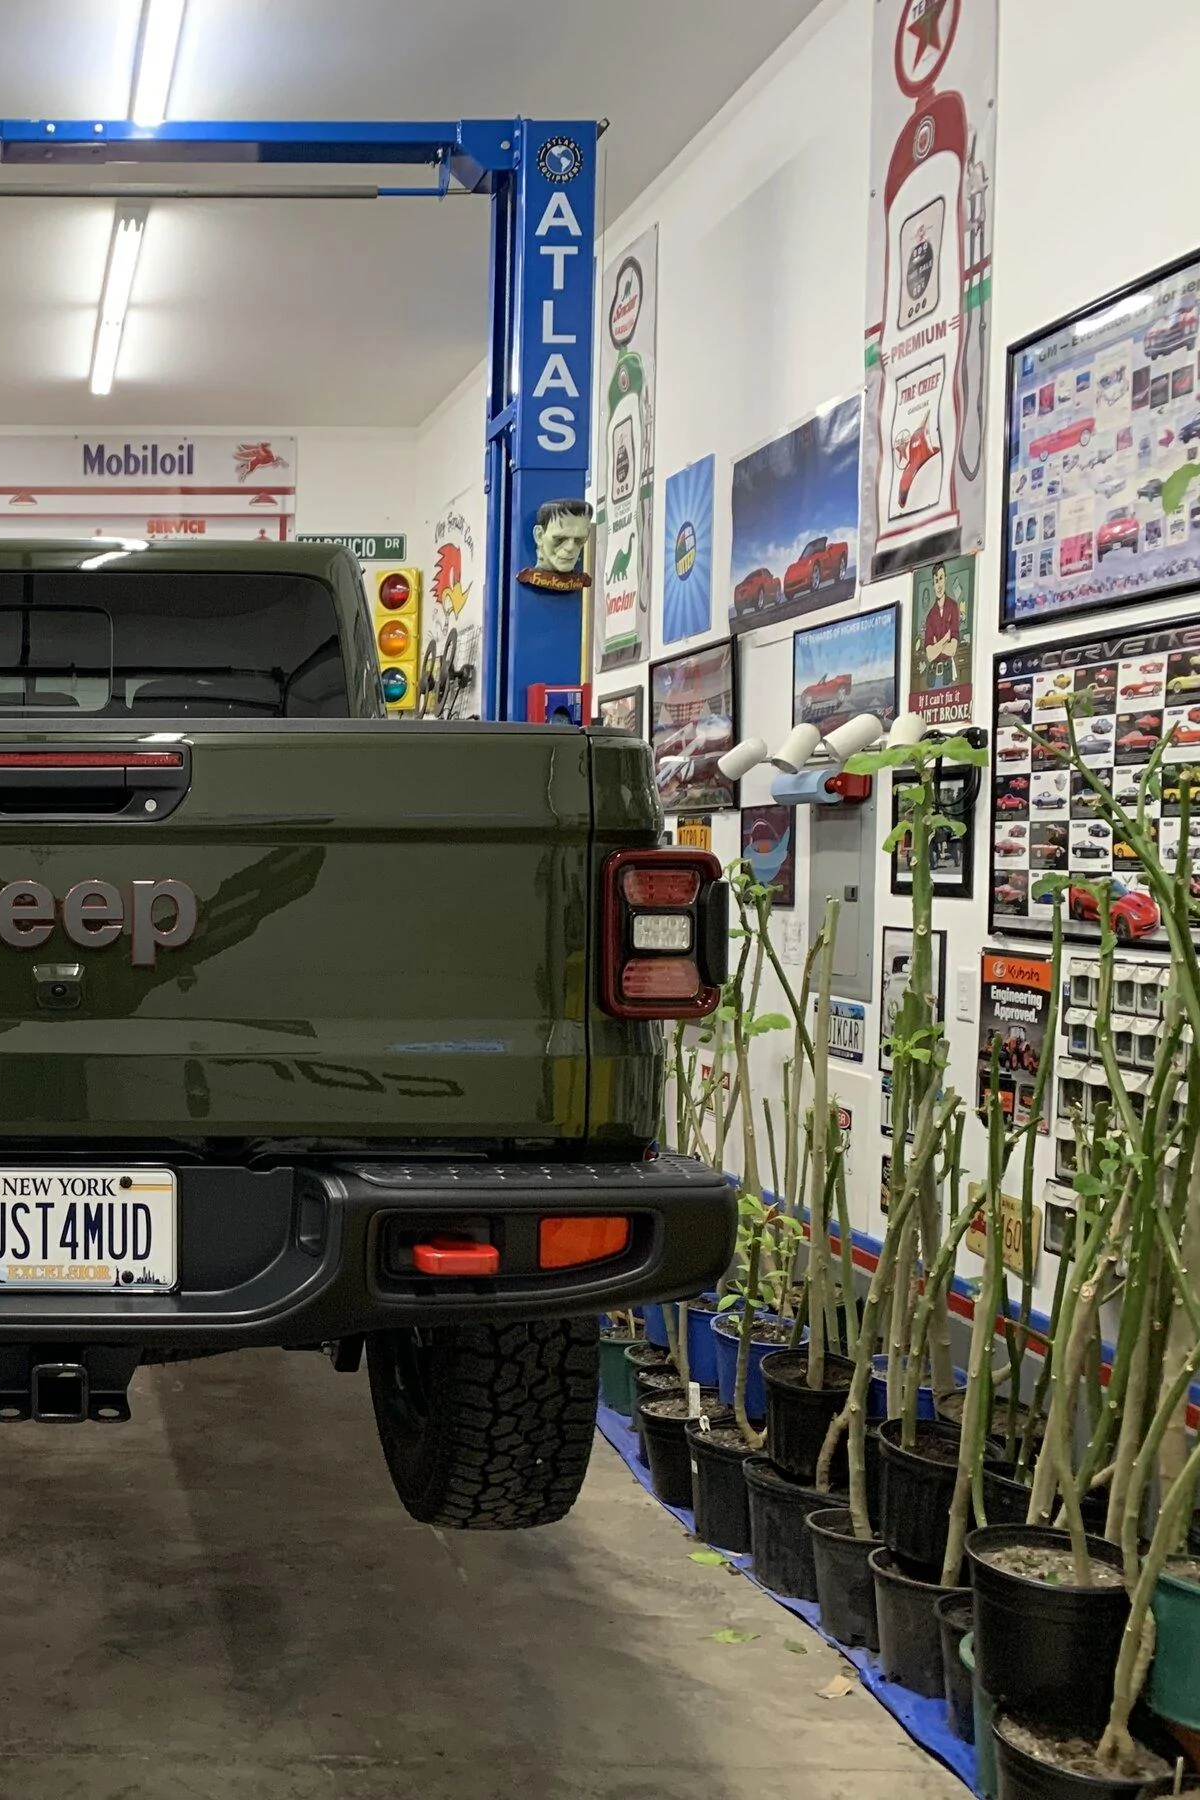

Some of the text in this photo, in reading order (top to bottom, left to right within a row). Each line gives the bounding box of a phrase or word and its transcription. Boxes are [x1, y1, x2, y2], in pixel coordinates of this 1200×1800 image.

[546, 138, 576, 149] ATLAS
[532, 192, 583, 451] ATLAS
[891, 320, 947, 363] PREMIUM
[917, 373, 941, 397] CHIEF
[83, 443, 194, 476] Mobiloil
[146, 519, 206, 534] SERVICE
[384, 538, 400, 549] DR
[606, 590, 636, 615] Sinclair
[860, 613, 892, 631] EDUCATION
[929, 692, 944, 706] can't
[939, 700, 973, 721] BROKE!
[1007, 965, 1040, 982] Kubota
[990, 985, 1043, 1010] Engineering
[993, 1003, 1038, 1024] Approved.
[2, 1177, 117, 1197] NEW YORK
[7, 1265, 112, 1281] EXCELSIOR
